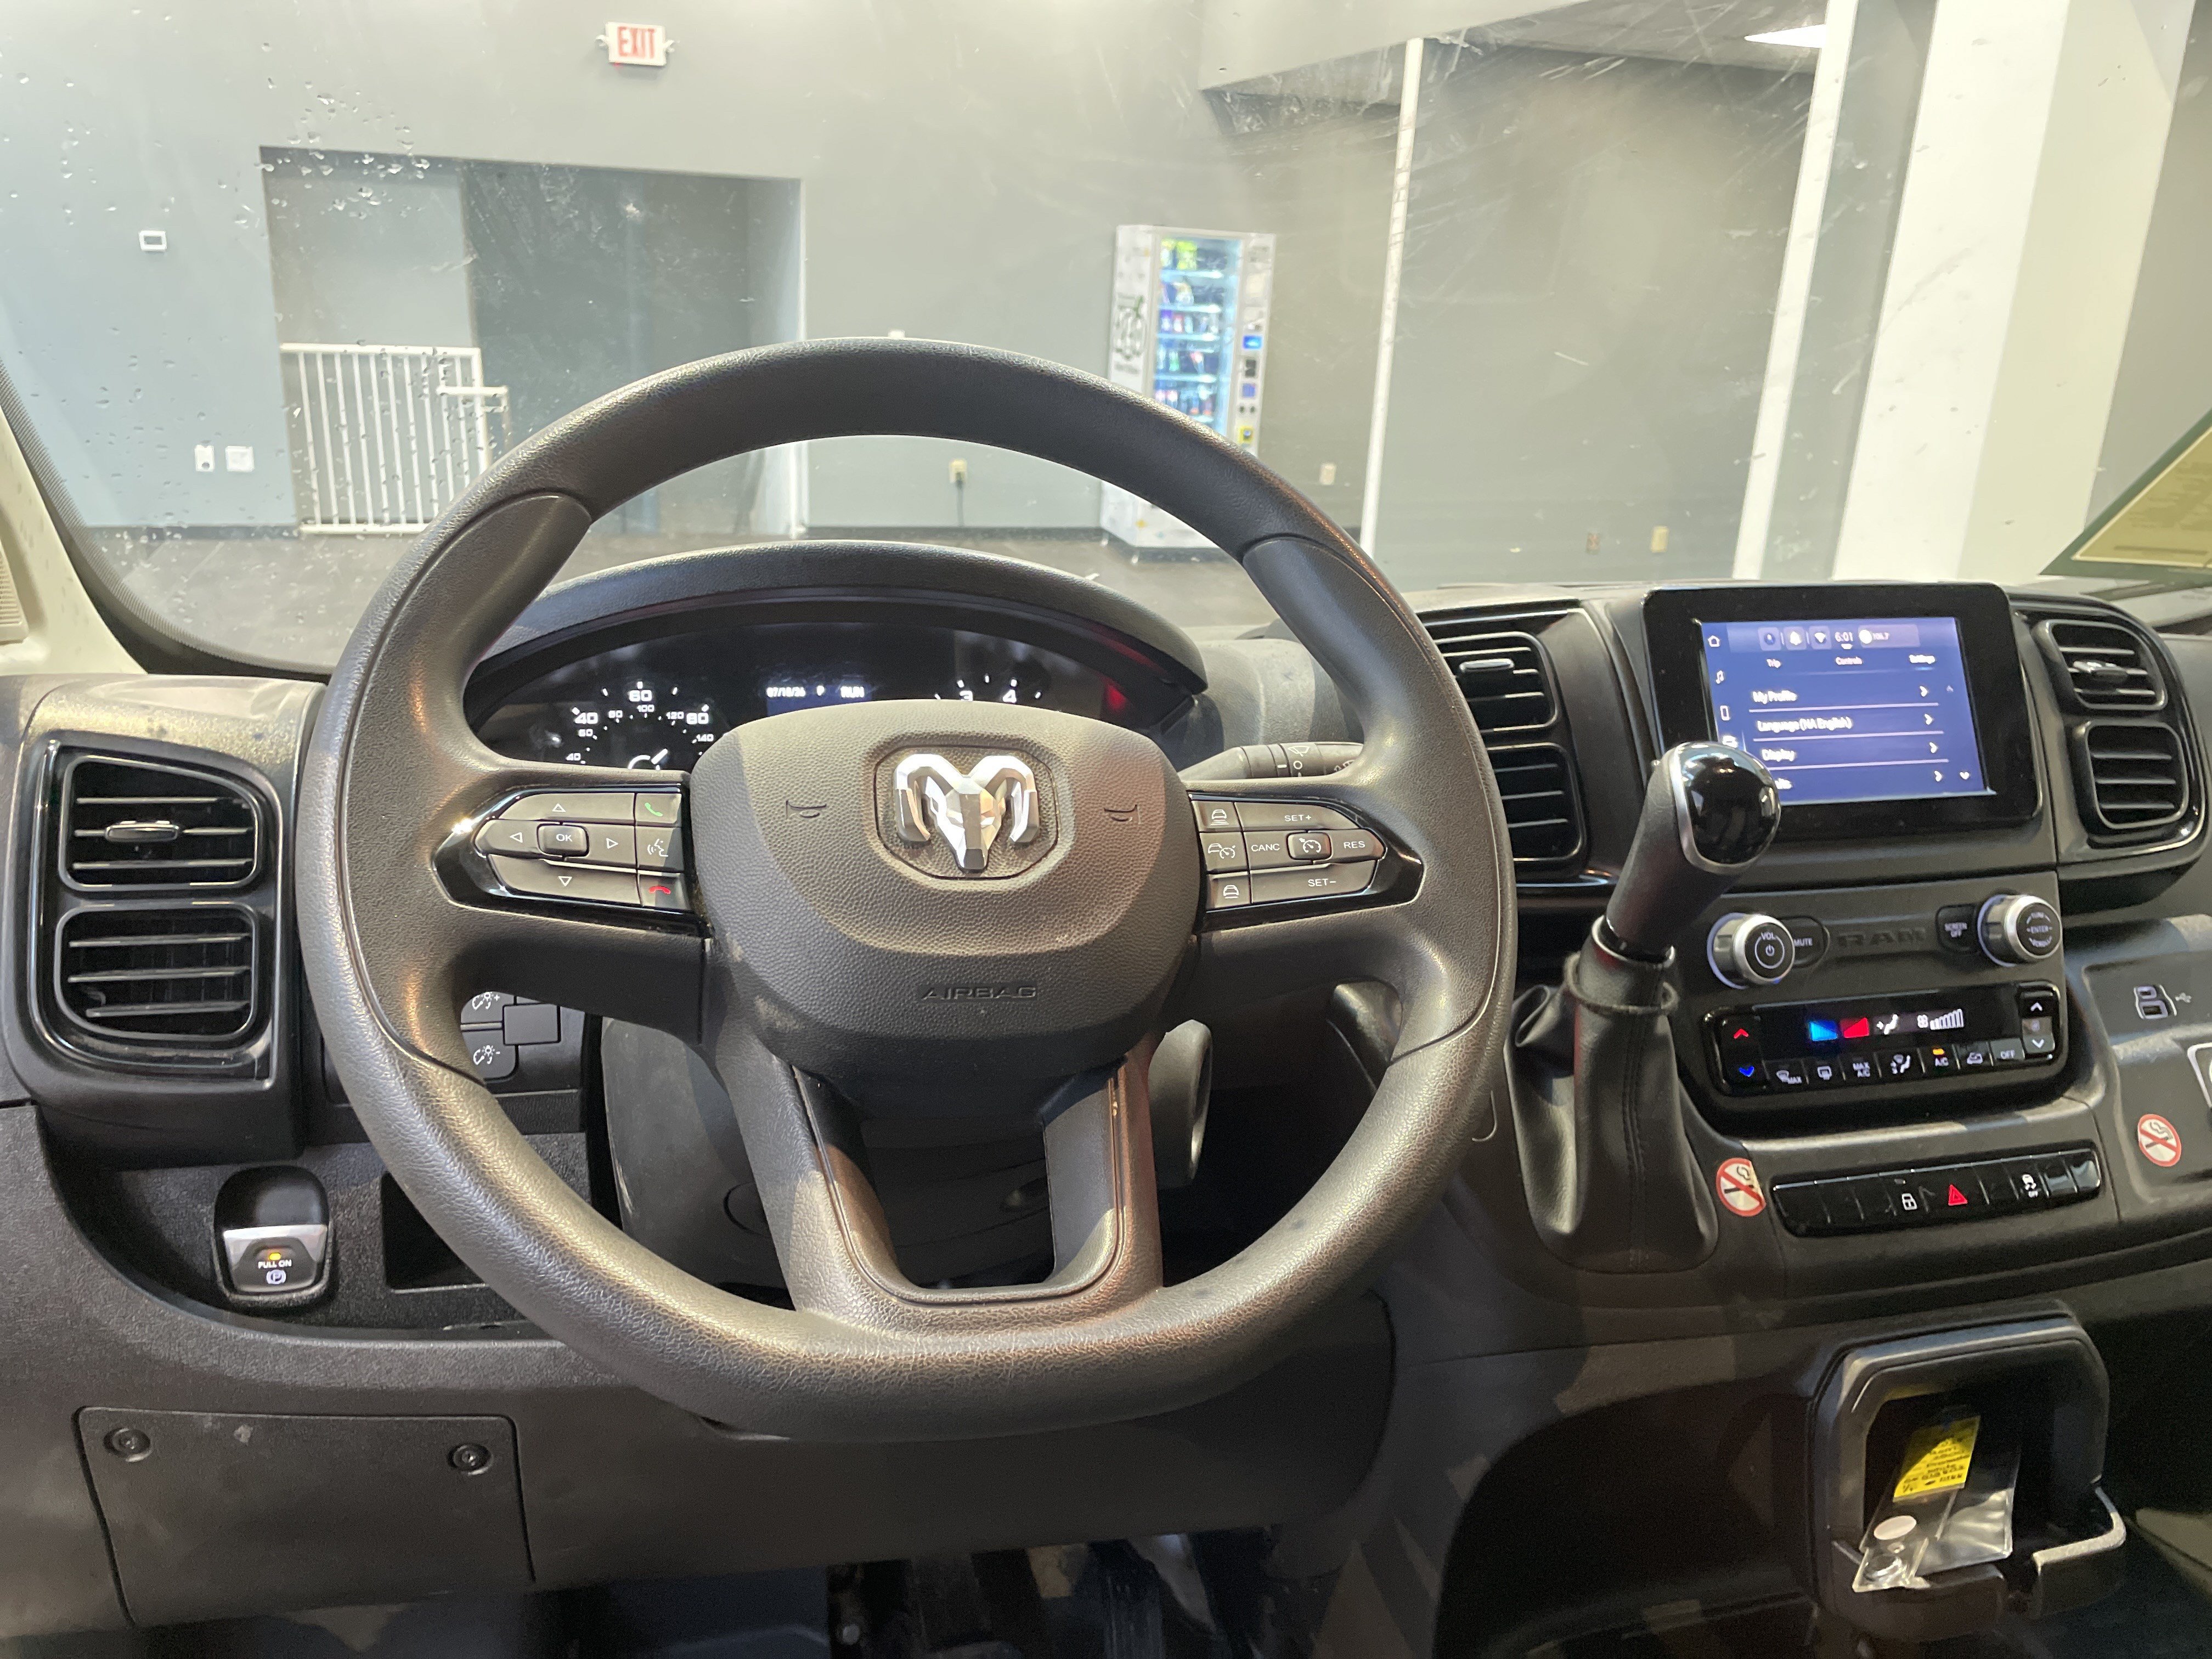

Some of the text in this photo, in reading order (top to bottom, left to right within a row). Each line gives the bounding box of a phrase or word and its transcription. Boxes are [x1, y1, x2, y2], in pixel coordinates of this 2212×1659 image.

[617, 26, 656, 59] EXIT
[629, 690, 653, 702] 60
[1002, 689, 1017, 703] 4
[637, 704, 655, 713] 100
[574, 712, 599, 725] 40
[666, 711, 685, 720] 120
[686, 712, 709, 725] 80
[696, 733, 714, 742] 140
[566, 752, 581, 761] 40
[556, 833, 572, 842] OK
[1251, 843, 1280, 851] CANC
[1344, 840, 1365, 849] RES
[1761, 932, 1775, 940] VOL
[1794, 938, 1813, 946] MUTE
[921, 987, 1036, 1000] AIRBAG
[2000, 1049, 2015, 1059] OFF
[258, 1261, 277, 1269] PULL
